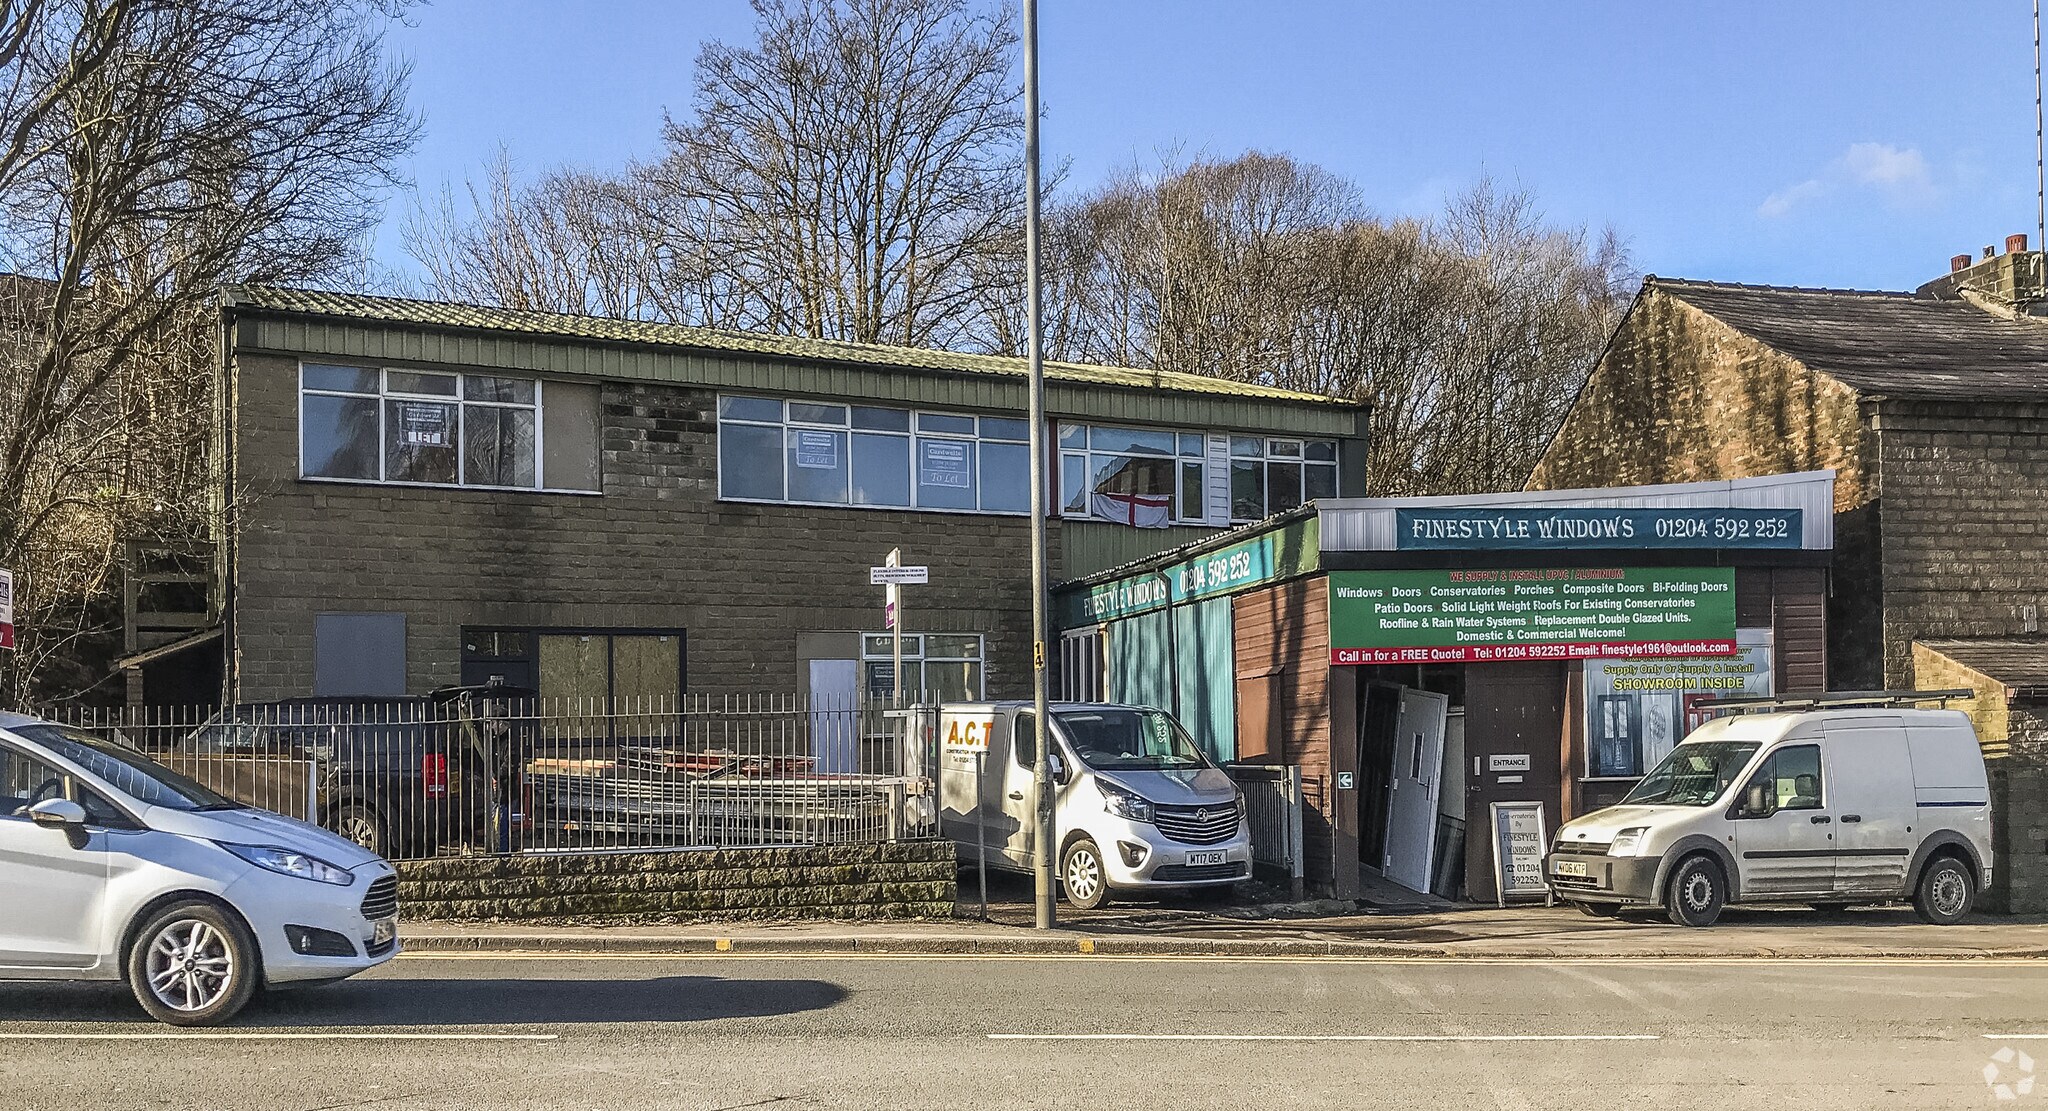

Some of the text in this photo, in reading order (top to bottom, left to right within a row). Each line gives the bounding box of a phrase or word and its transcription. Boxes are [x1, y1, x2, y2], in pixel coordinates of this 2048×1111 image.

[930, 472, 959, 483] To Let
[1412, 516, 1788, 541] FINESTYLE WINDOWS 01204 592 252
[1449, 571, 1463, 582] WE
[1465, 571, 1498, 582] SUPPLY
[1500, 571, 1507, 581] &
[1509, 570, 1545, 581] INSTALL
[1545, 569, 1569, 580] UPVC
[1083, 550, 1251, 617] FINESTYLE WINDOWS 01204 592 252
[1337, 581, 1728, 598] Windows Doors Conservatories Porches Composite Doors Bi-Folding Doors
[1374, 597, 1696, 614] Patio Doors Solid Light Weight Roofs For Existing Conservatories
[1379, 612, 1692, 629] Roofline & Rain Water Systems Replacement Double Glazed Units.
[1456, 627, 1626, 641] Domestic & Commercial Welcome!
[1338, 650, 1359, 662] Call
[1362, 650, 1372, 661] in
[1374, 649, 1390, 661] for
[1391, 651, 1398, 661] a
[1401, 649, 1428, 660] FREE
[1430, 648, 1465, 660] Quote!
[1473, 647, 1493, 659] Tel:
[1495, 646, 1527, 658] 01204
[1528, 645, 1566, 657] 592252
[1568, 644, 1600, 656] Email:
[1601, 642, 1730, 657] finestyle1961@outlook.com
[1603, 663, 1755, 675] Supply Only Or Supply & Install
[1613, 677, 1745, 691] SHOWROOM INSIDE
[1493, 759, 1526, 767] ENTRANCE
[1515, 821, 1523, 829] By
[1503, 832, 1539, 842] FINESTYLE
[1507, 844, 1537, 853] WINDOWS
[1190, 854, 1207, 865] MT17
[1516, 864, 1540, 873] 01204
[1573, 863, 1586, 875] KTP
[1511, 875, 1539, 885] 592252
